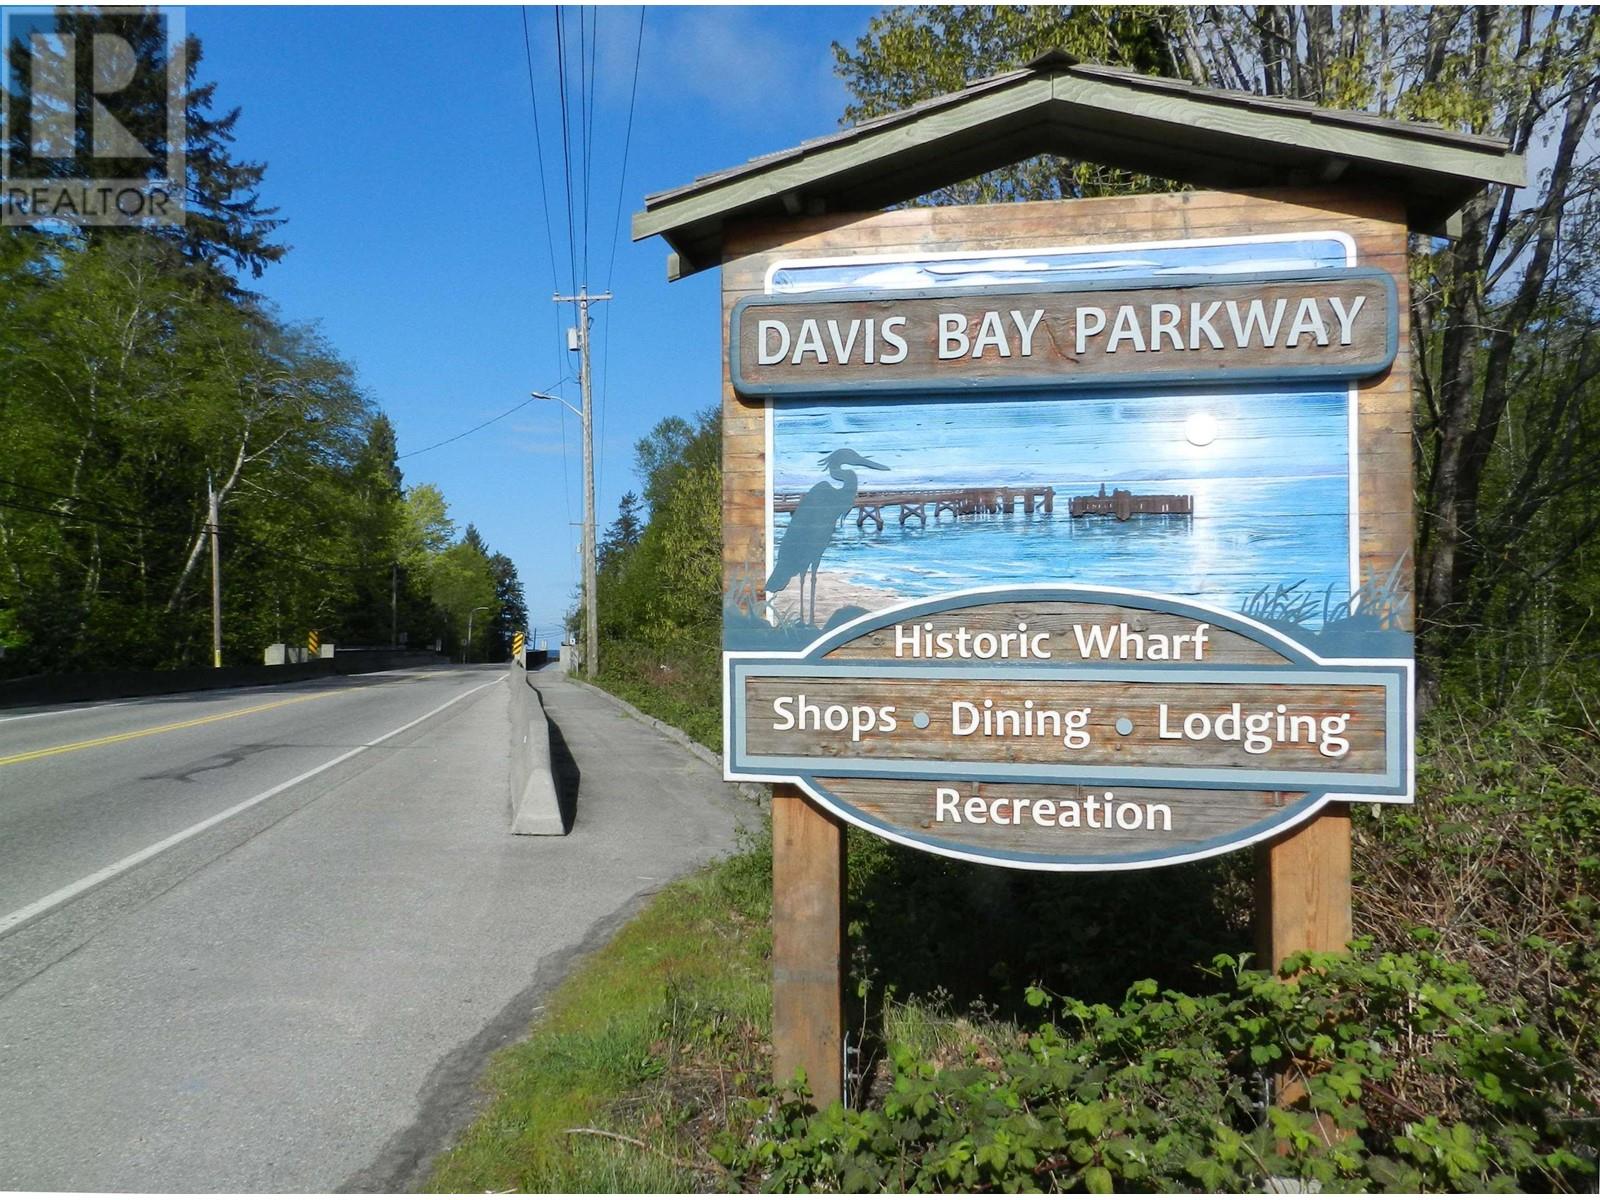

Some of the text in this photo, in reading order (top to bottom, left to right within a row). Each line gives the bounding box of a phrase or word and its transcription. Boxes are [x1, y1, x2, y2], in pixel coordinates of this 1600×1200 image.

[757, 295, 1367, 366] DAVIS BAY PARKWAY
[894, 622, 1210, 660] Historic Wharf
[772, 695, 1351, 757] Shops Dining Lodging
[935, 787, 1173, 831] Recreation
